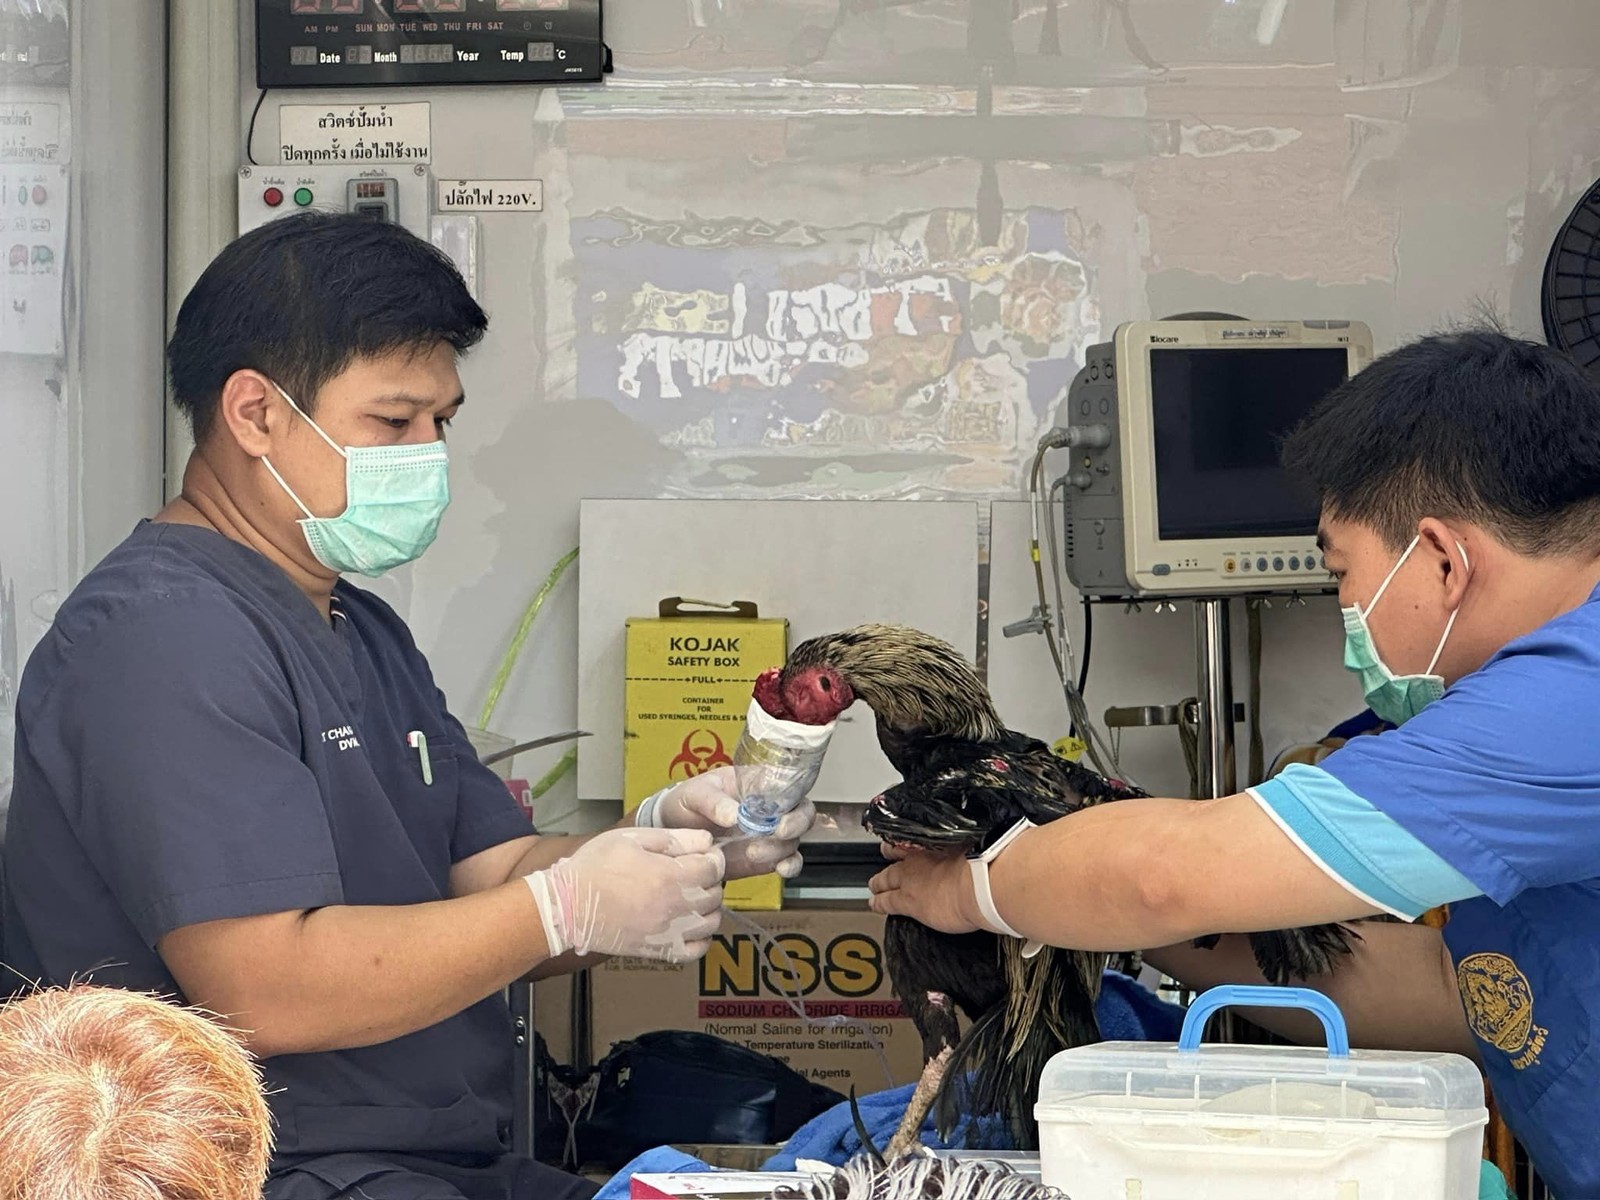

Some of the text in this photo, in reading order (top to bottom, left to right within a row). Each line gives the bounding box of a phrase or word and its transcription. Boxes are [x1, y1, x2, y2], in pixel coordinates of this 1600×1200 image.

[304, 25, 338, 33] AM PM
[355, 21, 504, 33] SUN MON TUE WED THU FRI SAT
[319, 52, 341, 63] Date
[374, 51, 398, 63] Month
[456, 50, 480, 61] Year
[500, 49, 525, 62] Temp
[282, 137, 347, 165] ปิดทุกครั้ง
[497, 193, 536, 206] 220V.
[669, 636, 741, 652] KOJAK
[667, 656, 740, 668] SAFETY BOX
[691, 676, 716, 684] FULL
[699, 933, 884, 997] NSS
[705, 1004, 766, 1017] SODIUM
[771, 1004, 849, 1017] CHORIDE
[704, 1022, 757, 1036] (Normal
[762, 1022, 803, 1035] Saline
[808, 1023, 826, 1035] for
[744, 1040, 815, 1052] Temperature
[811, 1068, 852, 1079] Agents
